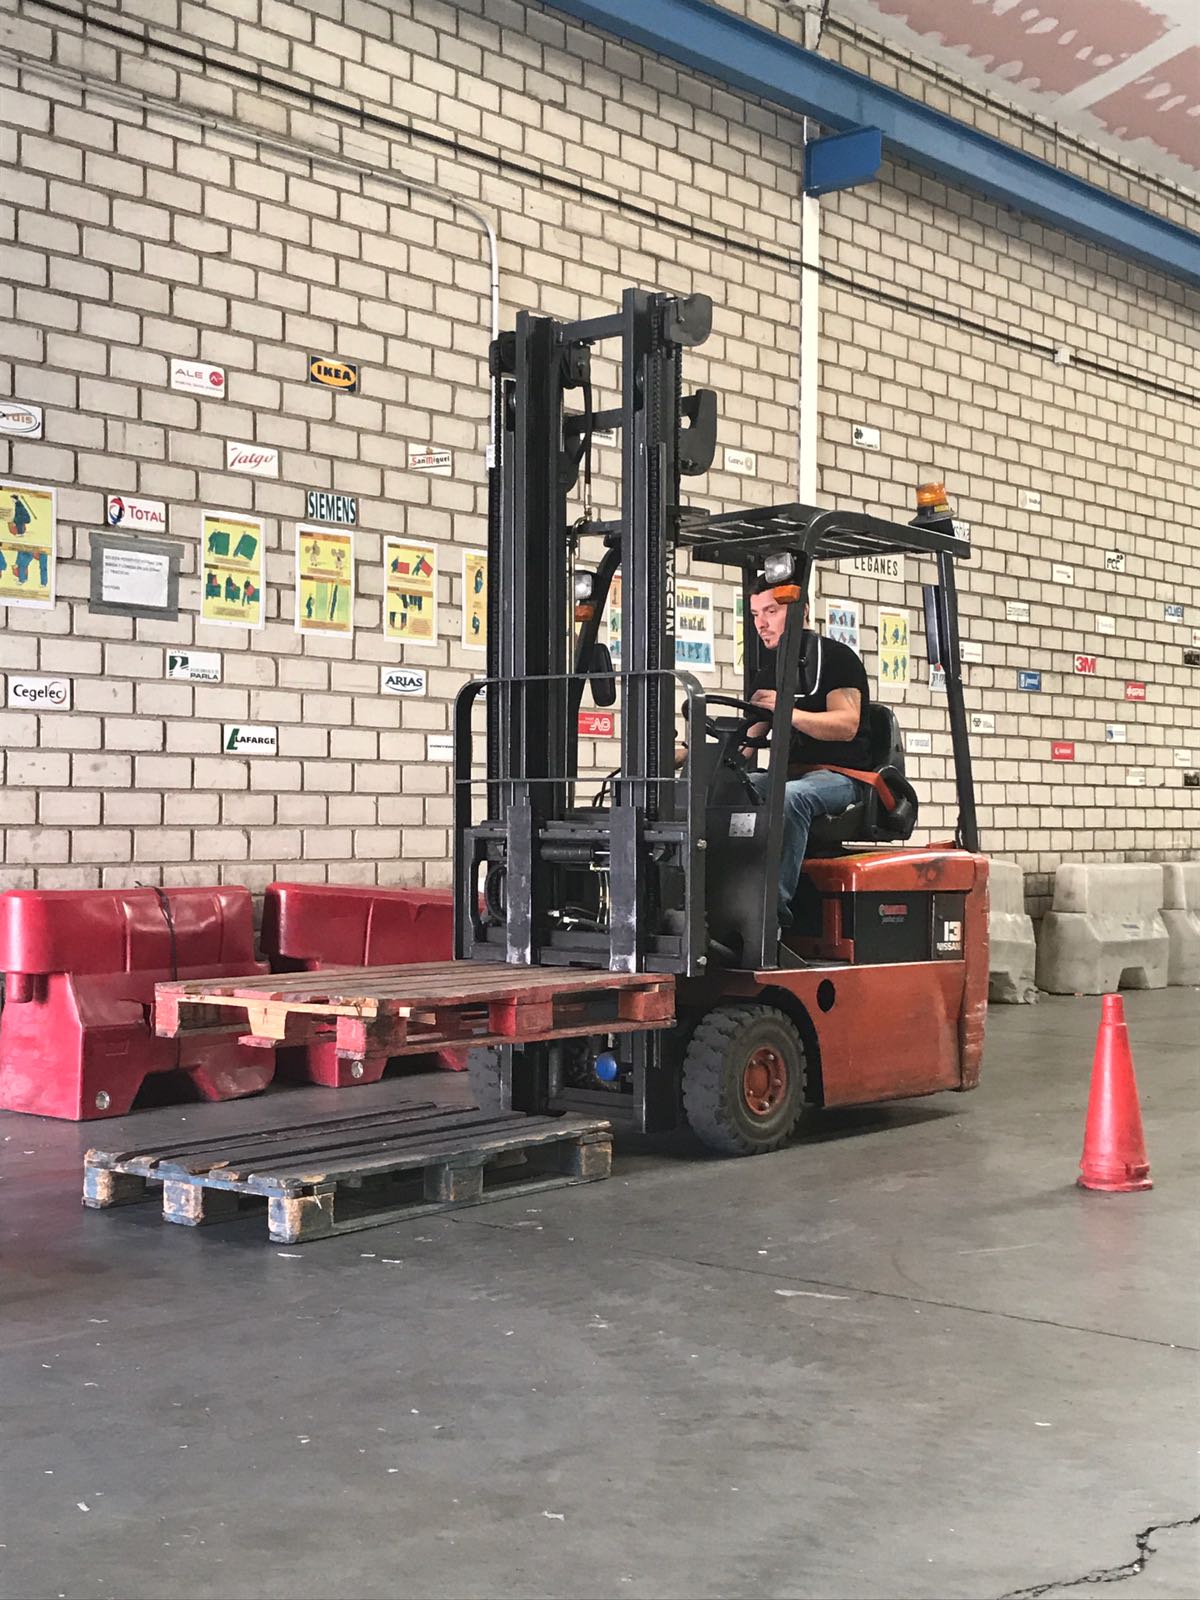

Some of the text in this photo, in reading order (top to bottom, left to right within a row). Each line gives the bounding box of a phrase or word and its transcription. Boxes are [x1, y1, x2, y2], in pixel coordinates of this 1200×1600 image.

[175, 368, 203, 379] ALE
[317, 364, 352, 382] IKEA
[229, 447, 276, 469] Talgo
[128, 504, 166, 524] TOTAL
[308, 491, 356, 524] SIEMENS
[854, 556, 898, 577] LEGANES
[1075, 656, 1097, 674] 3M
[190, 672, 219, 680] PARLA
[385, 675, 423, 688] ARIAS
[13, 684, 63, 702] Cegelec
[936, 942, 961, 951] NISSAN
